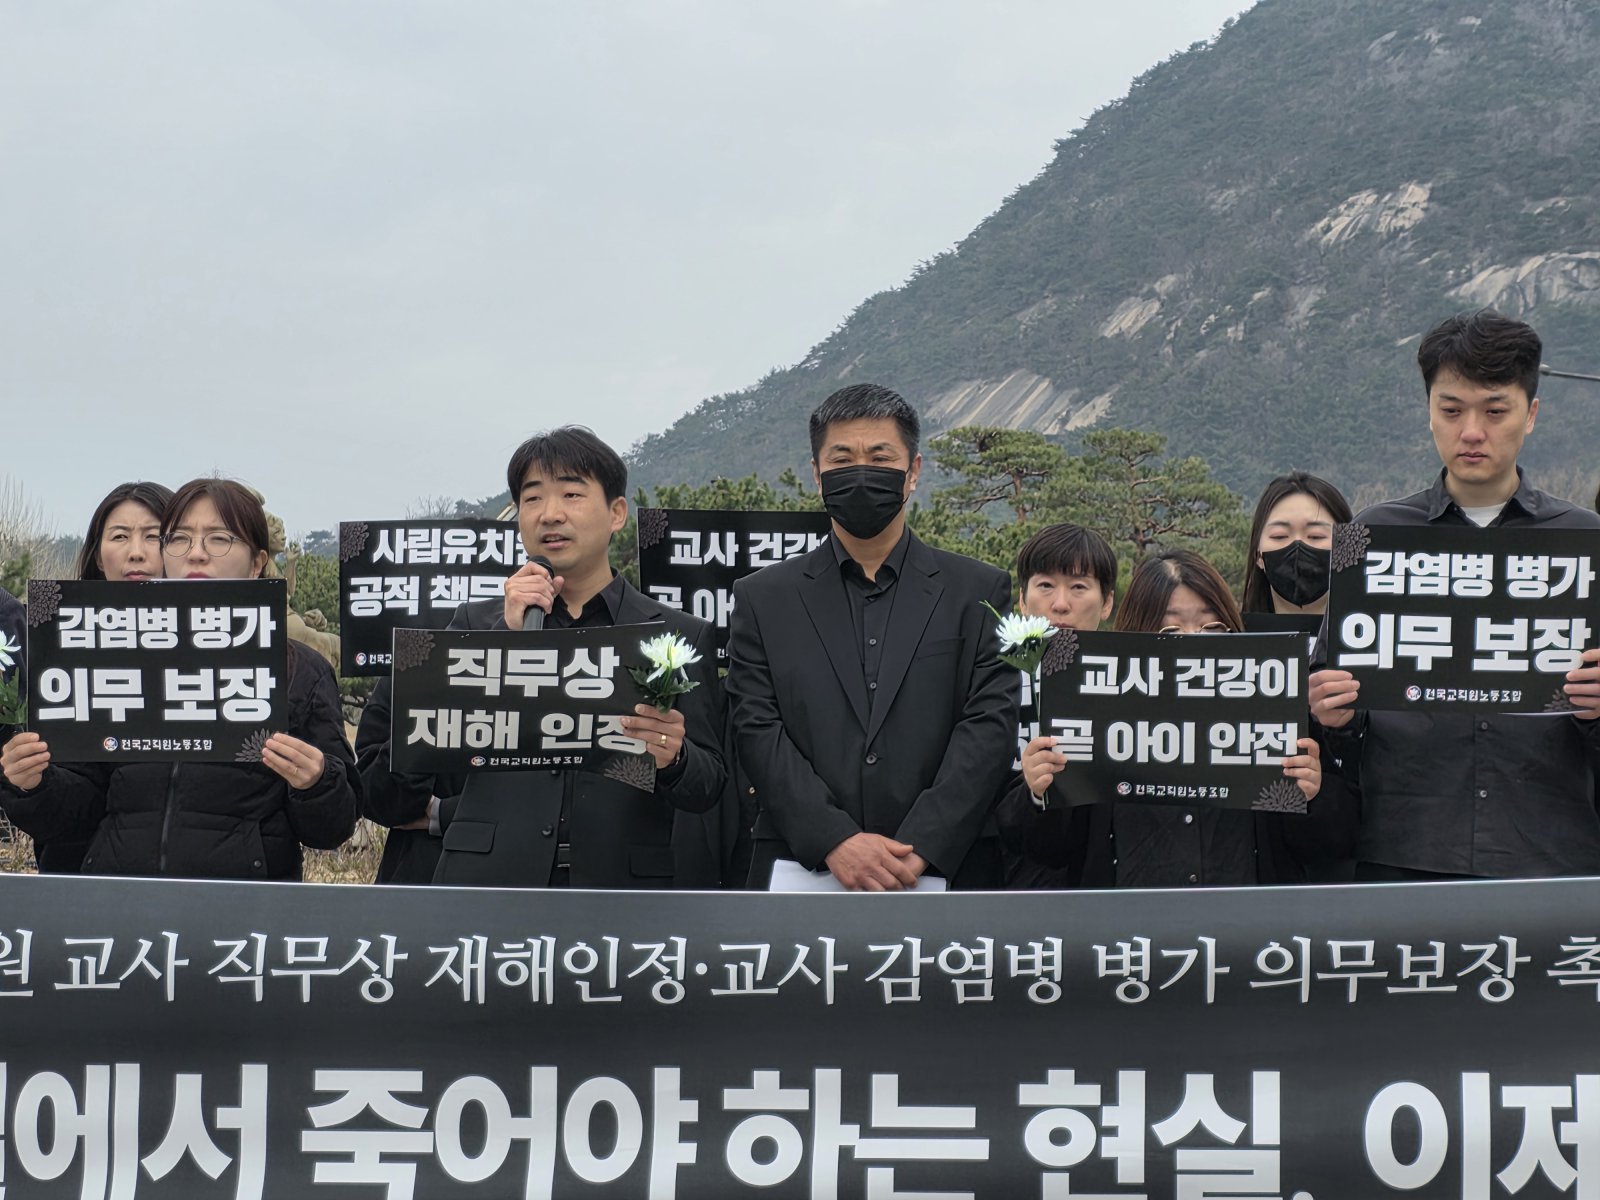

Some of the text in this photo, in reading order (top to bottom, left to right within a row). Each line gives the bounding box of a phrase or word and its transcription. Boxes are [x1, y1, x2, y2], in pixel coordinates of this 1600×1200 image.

[669, 530, 829, 568] 교사 건강
[349, 575, 420, 617] 공적
[1365, 551, 1596, 599] 감염병 병가
[58, 606, 277, 649] 감염병 병가
[692, 588, 736, 628] 아
[1338, 612, 1592, 673] 의무 보장
[447, 646, 620, 699] 직무상
[1079, 655, 1164, 697] 교사
[1175, 657, 1299, 698] 건강이
[38, 667, 276, 722] 의무 보장
[1424, 688, 1522, 703] 전국교직원노동조합
[121, 739, 213, 751] 전국교직원노동조합
[407, 708, 520, 750] 재해
[1050, 718, 1094, 761] 곧
[1107, 720, 1196, 764] 아이
[1208, 722, 1298, 766] 안전
[1135, 784, 1229, 799] 전국교직원노동조합
[53, 930, 190, 1002] 교사
[207, 932, 409, 1003] 직무상
[864, 935, 1063, 1005] 감염병
[1091, 935, 1231, 1004] 병가
[1249, 934, 1532, 1004] 의무보장
[0, 1061, 268, 1200] 에서
[301, 1066, 699, 1200] 죽어야
[723, 1068, 990, 1200] 하는
